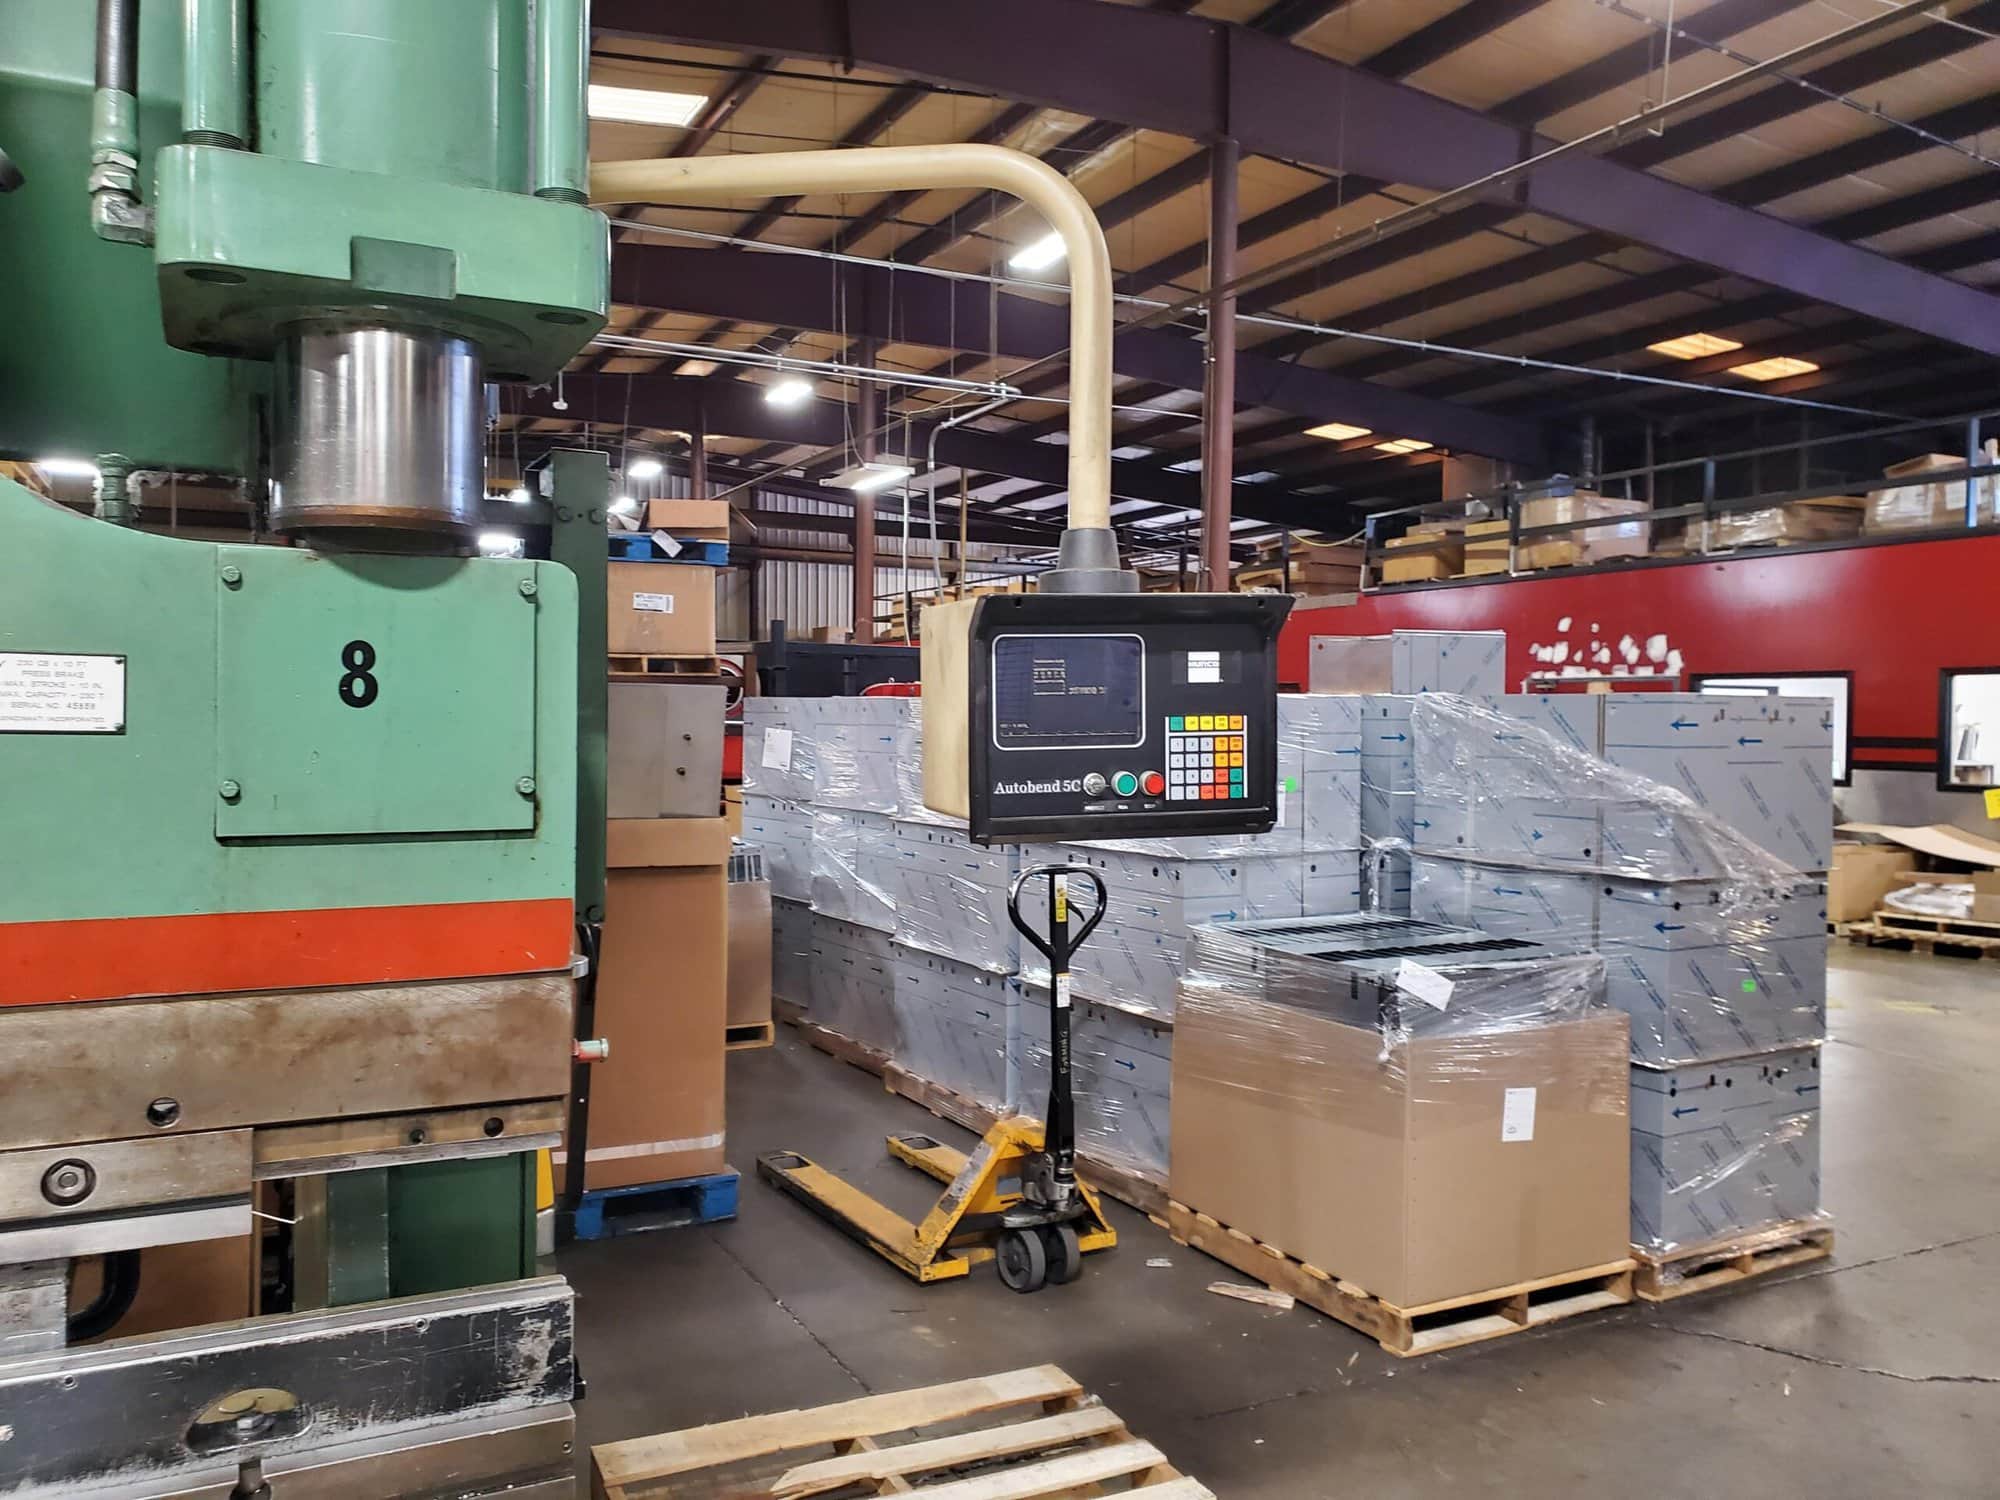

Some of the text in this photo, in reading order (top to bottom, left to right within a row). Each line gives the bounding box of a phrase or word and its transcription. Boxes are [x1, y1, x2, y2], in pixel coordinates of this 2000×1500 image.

[339, 640, 378, 708] 8
[993, 779, 1081, 794] Autobend 5C
